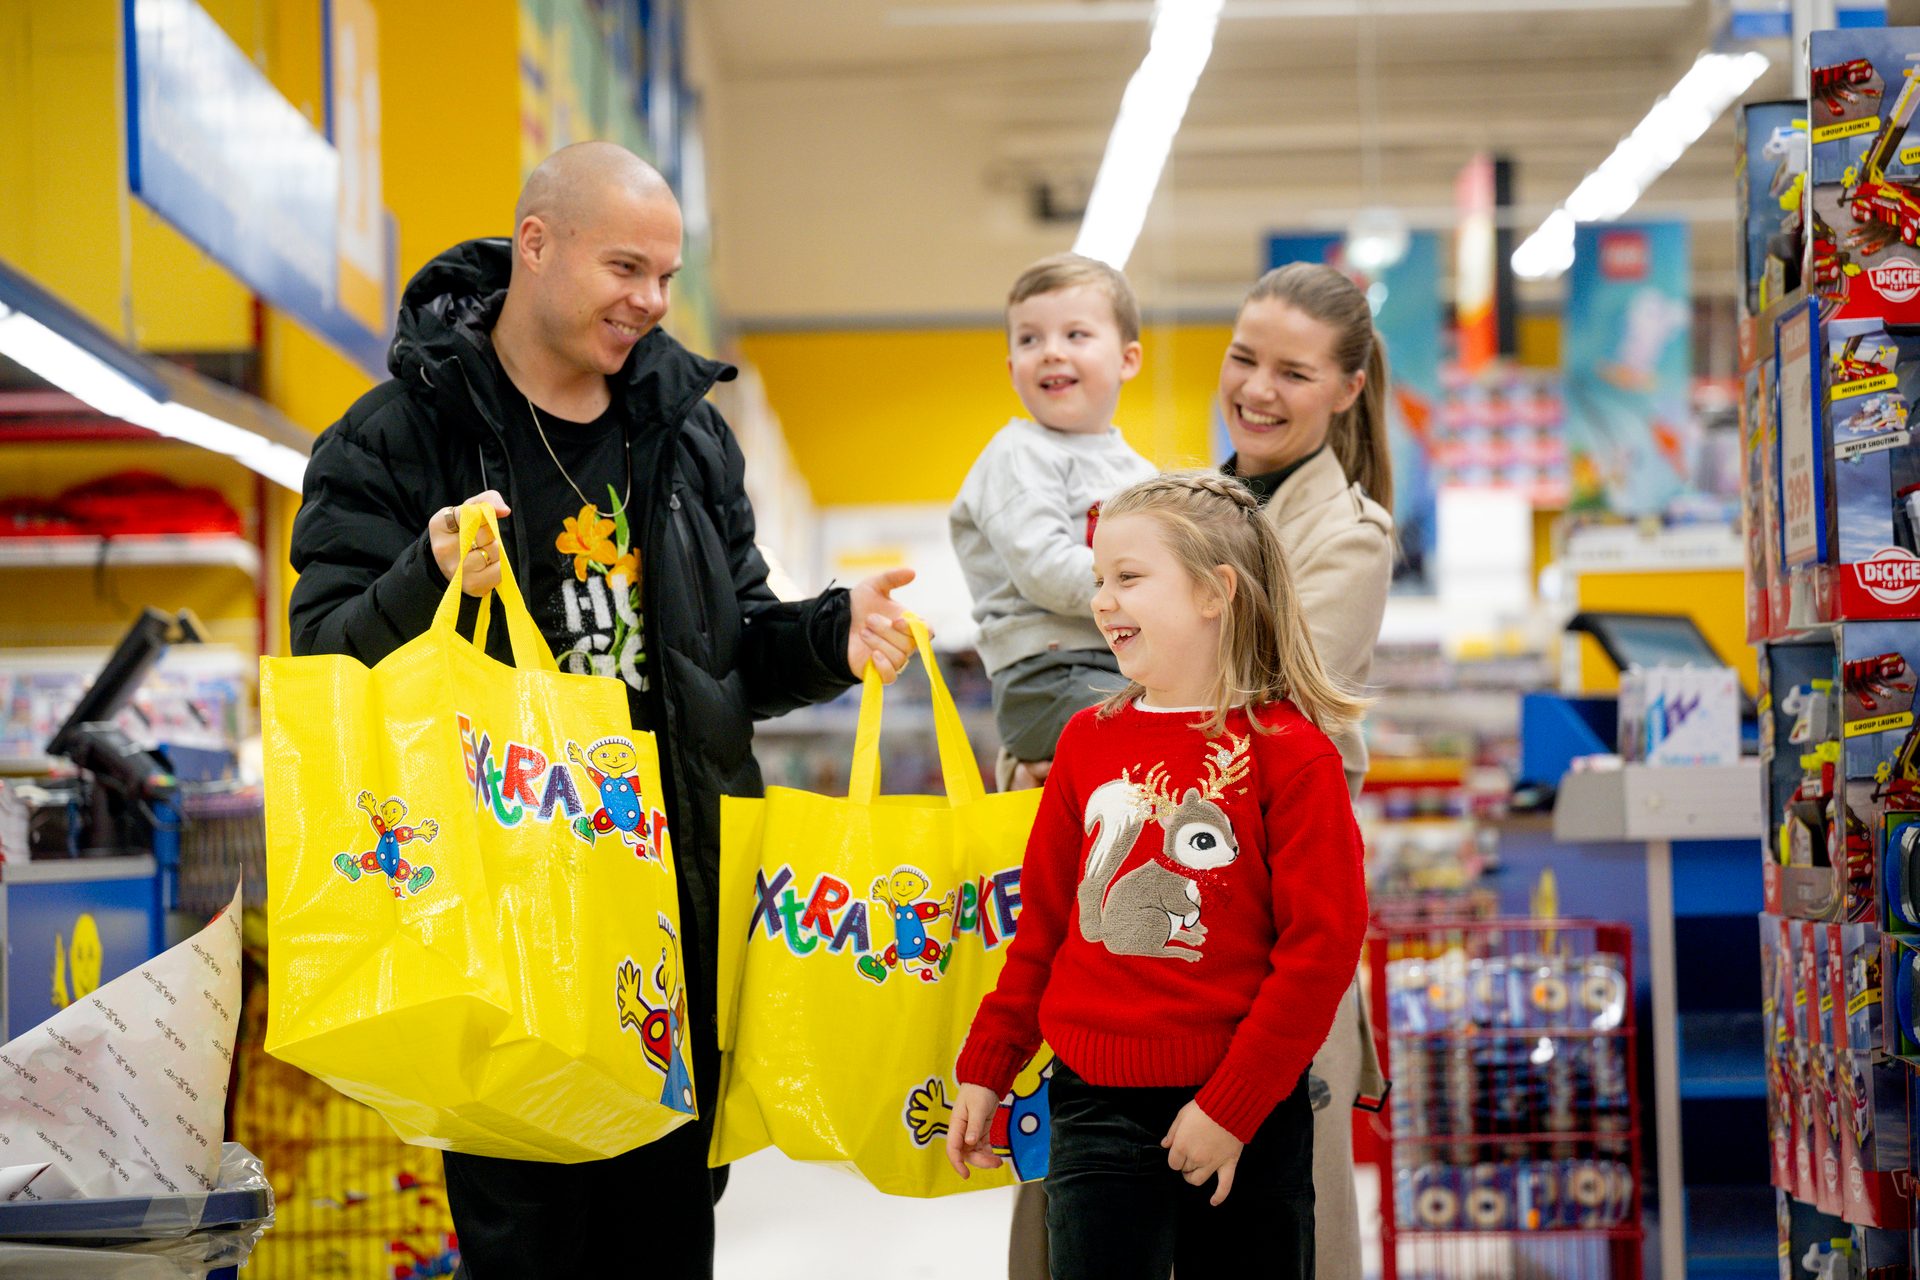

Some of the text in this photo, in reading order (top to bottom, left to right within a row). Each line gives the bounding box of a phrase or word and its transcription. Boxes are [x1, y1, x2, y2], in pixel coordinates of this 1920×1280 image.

[1821, 121, 1870, 137] GROUP LAUNCH
[1842, 379, 1886, 393] MOVING ARMS
[1845, 435, 1899, 452] WATER SHOOTING
[1854, 716, 1903, 731] GROUP LAUNCH
